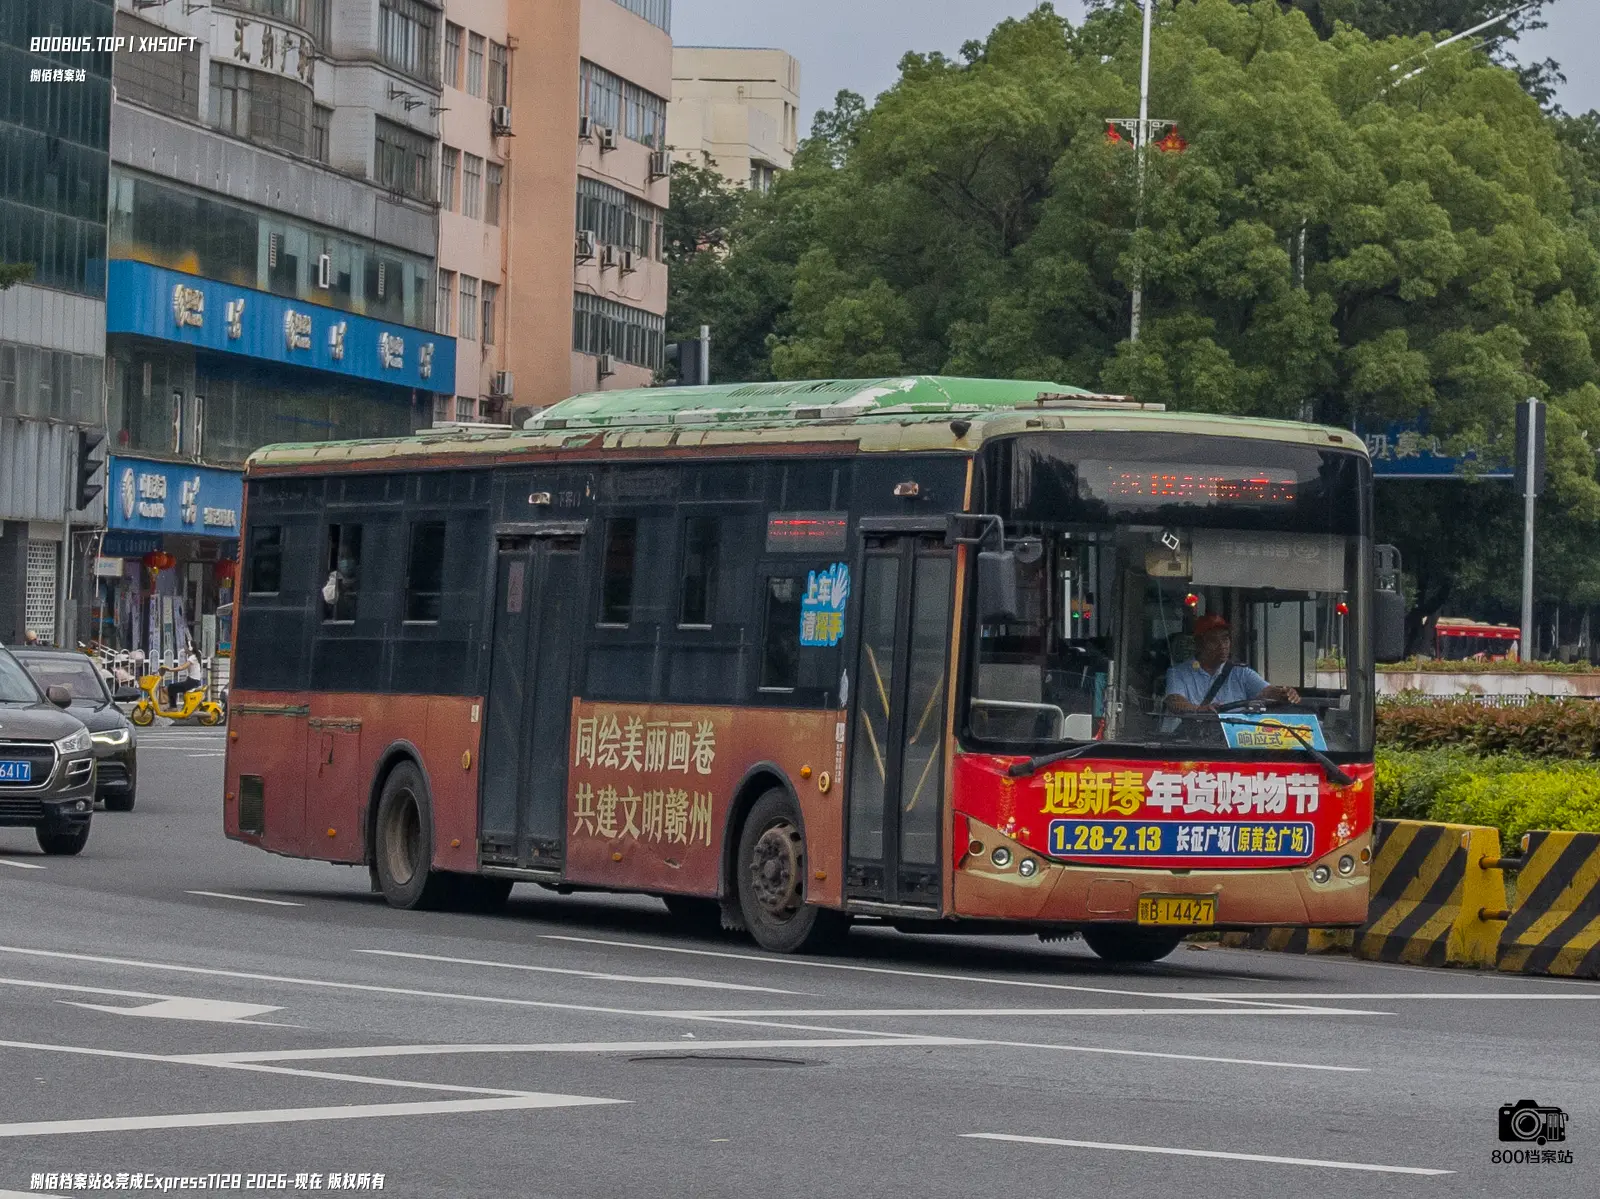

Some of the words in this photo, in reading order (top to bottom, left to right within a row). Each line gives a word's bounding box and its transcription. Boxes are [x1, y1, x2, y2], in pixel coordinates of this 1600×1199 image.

[574, 713, 716, 775] 同绘美丽画卷
[1238, 732, 1284, 746] 响应式
[572, 782, 713, 847] 共建文明赣州
[1040, 767, 1320, 816] 迎新春年货购物节
[1053, 825, 1162, 852] 1.28-2.13
